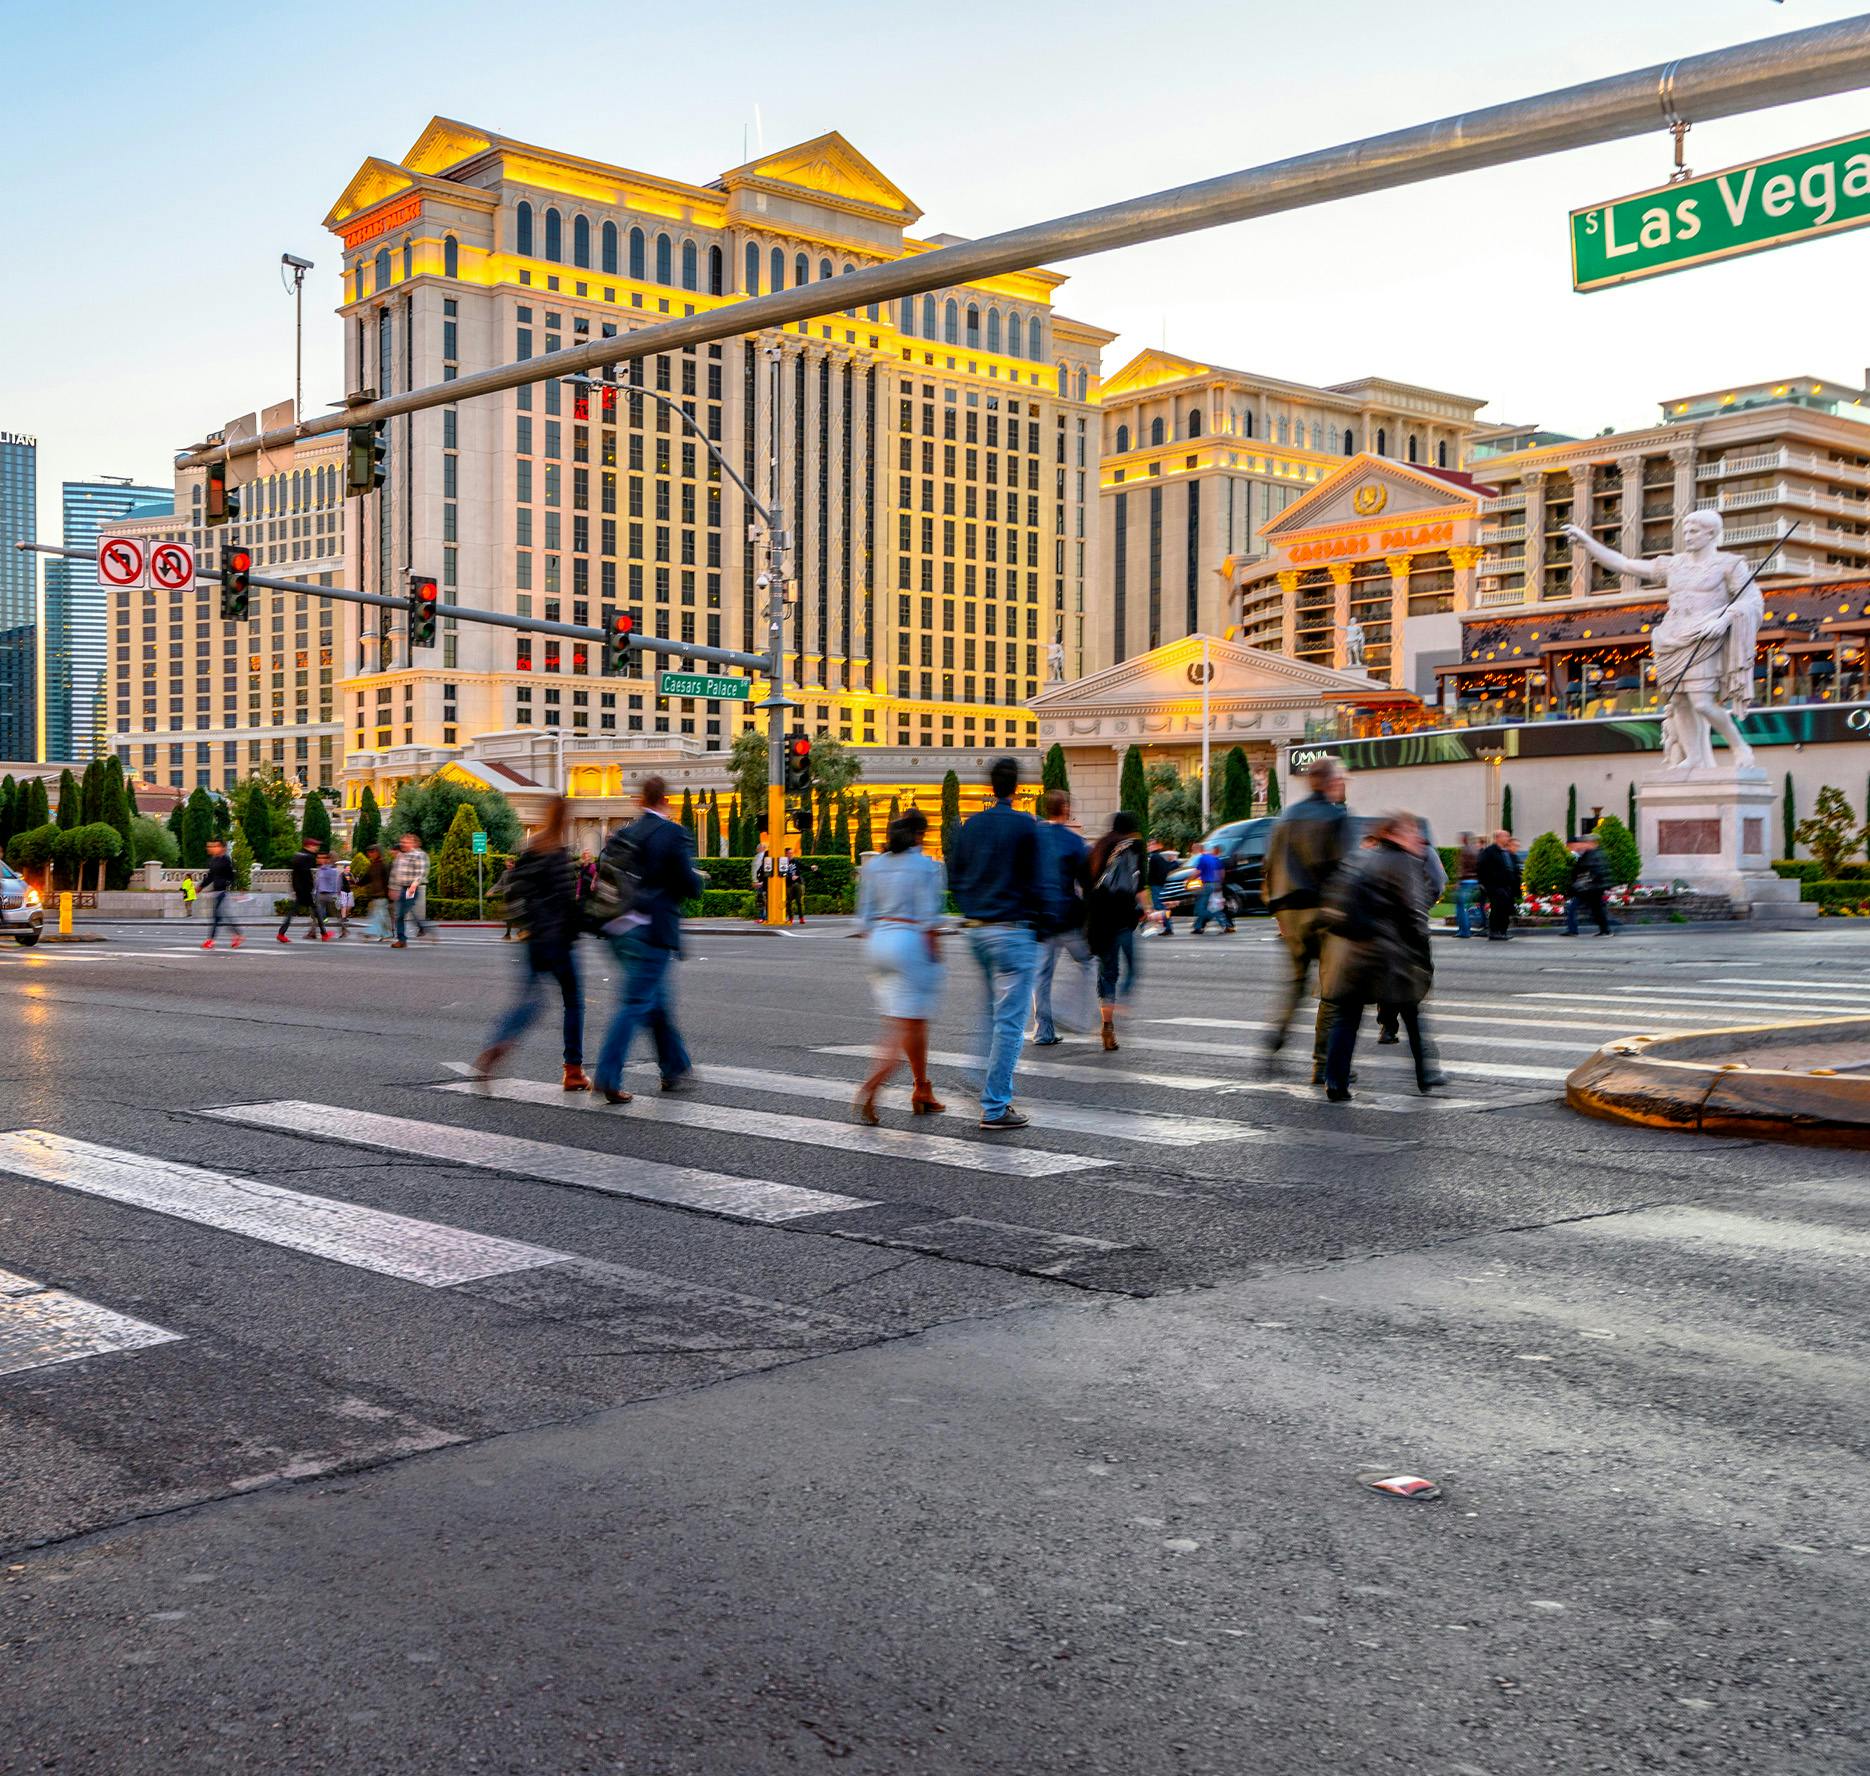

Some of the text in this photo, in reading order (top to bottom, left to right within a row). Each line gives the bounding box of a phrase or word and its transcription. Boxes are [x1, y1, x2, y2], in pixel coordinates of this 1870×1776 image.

[345, 220, 384, 250] CAESARS
[1585, 211, 1598, 234] S
[1604, 199, 1701, 259] Las
[1288, 522, 1454, 563] CAESARS PALACE
[664, 676, 701, 694] Caesars
[706, 679, 738, 696] Palace
